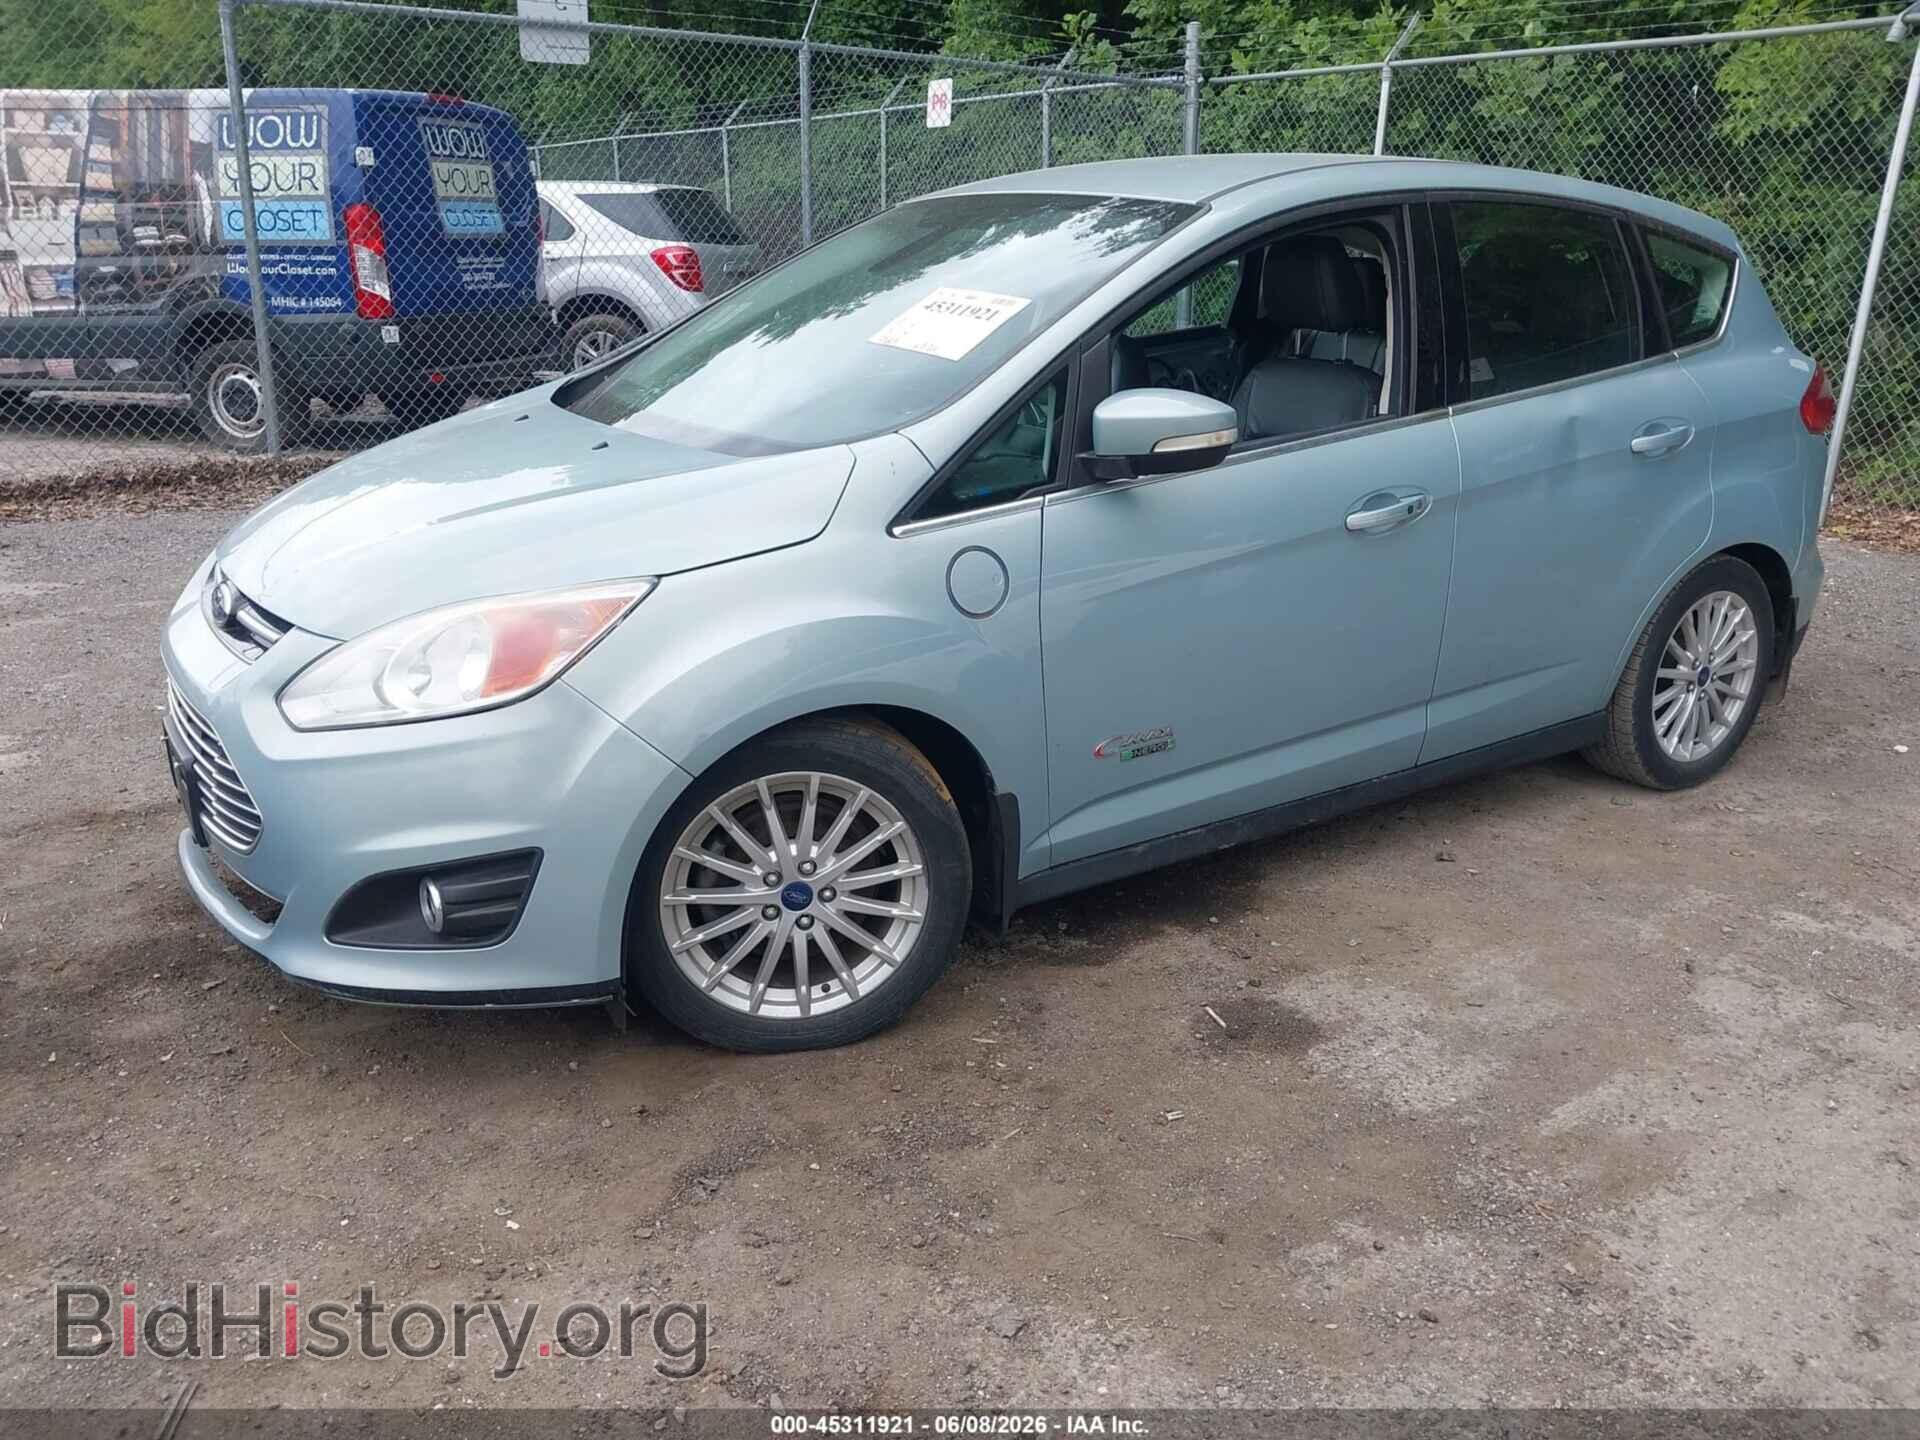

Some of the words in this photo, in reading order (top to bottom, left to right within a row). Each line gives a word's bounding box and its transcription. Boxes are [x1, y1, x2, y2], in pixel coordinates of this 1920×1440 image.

[425, 126, 486, 159] WOW
[436, 167, 493, 195] YOUR
[227, 208, 322, 232] COSET
[444, 208, 499, 227] CLOSET
[271, 296, 299, 307] MHIC
[923, 299, 1001, 321] 45311921
